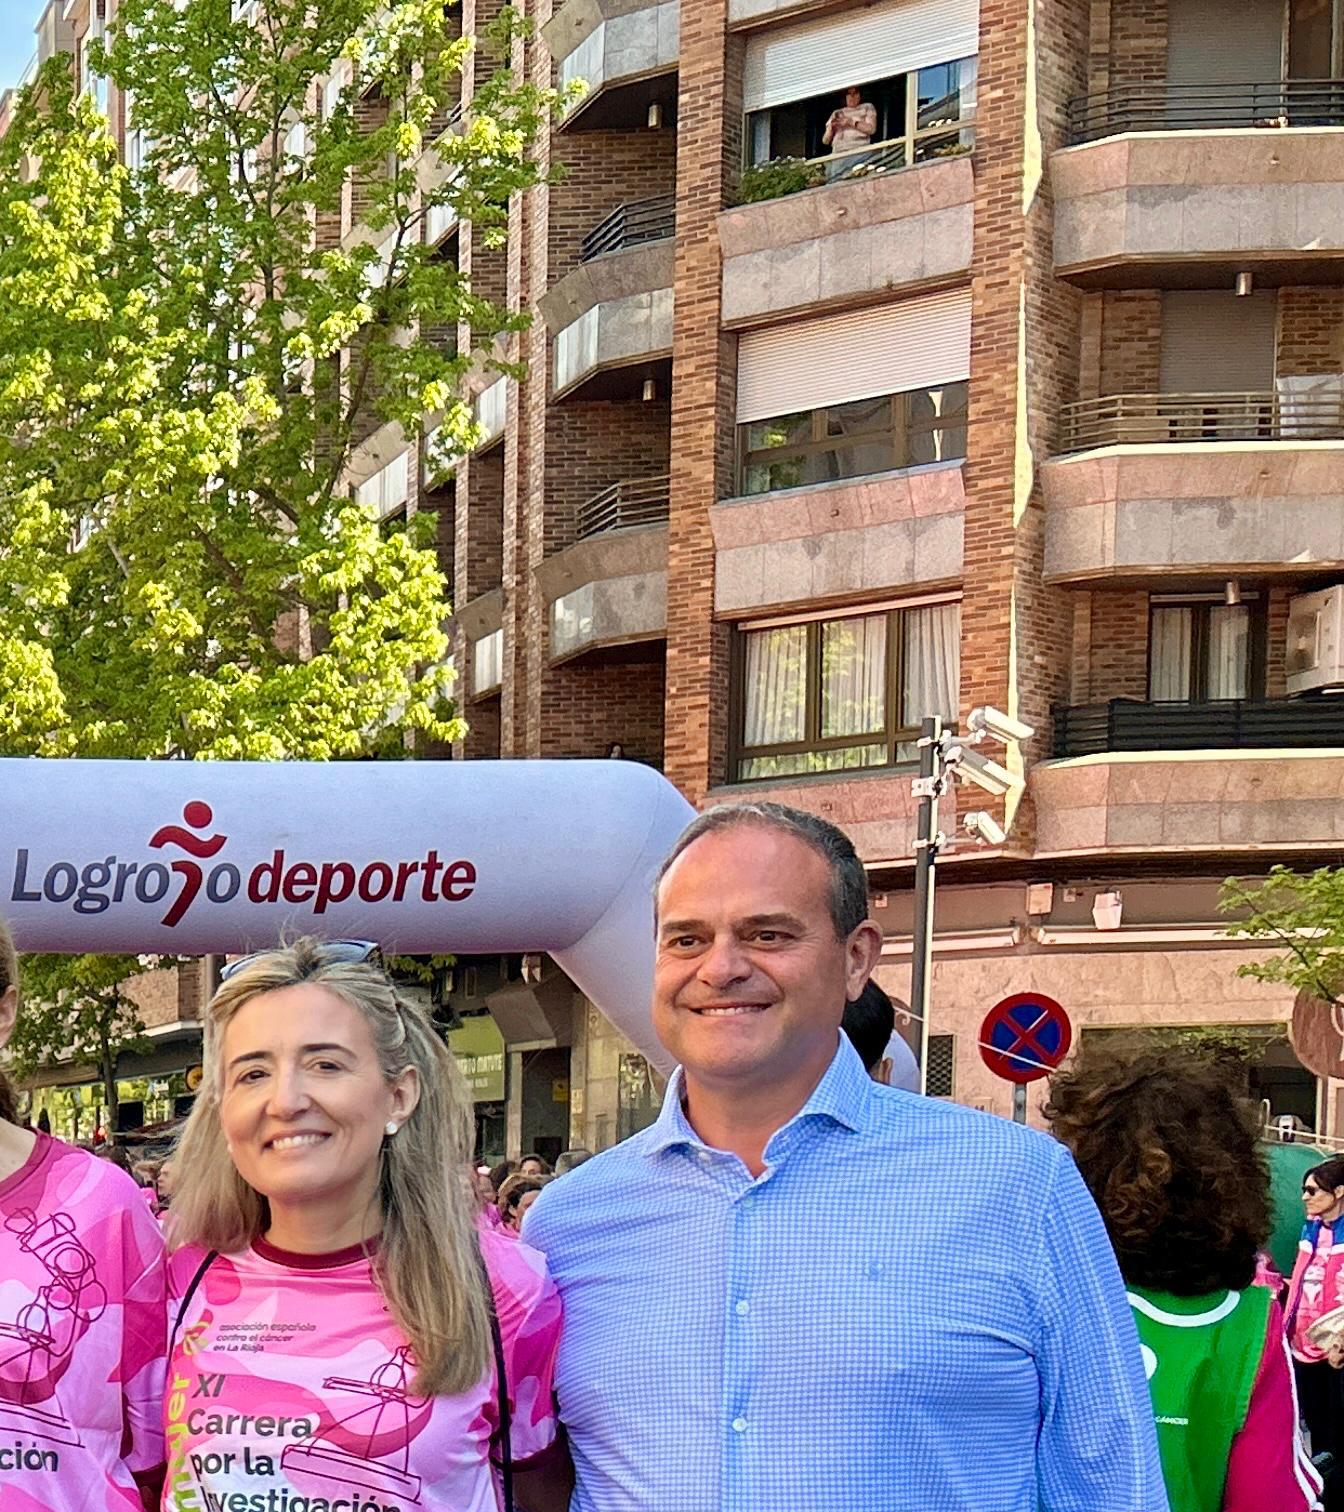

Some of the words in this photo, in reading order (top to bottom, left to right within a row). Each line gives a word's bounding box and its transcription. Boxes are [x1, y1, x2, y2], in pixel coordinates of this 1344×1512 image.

[247, 849, 477, 915] deporte
[213, 1344, 226, 1352] en
[226, 1344, 239, 1352] La
[191, 1373, 227, 1399] XI
[186, 1407, 313, 1439] Carrera
[189, 1451, 237, 1482] por
[243, 1446, 275, 1476] la
